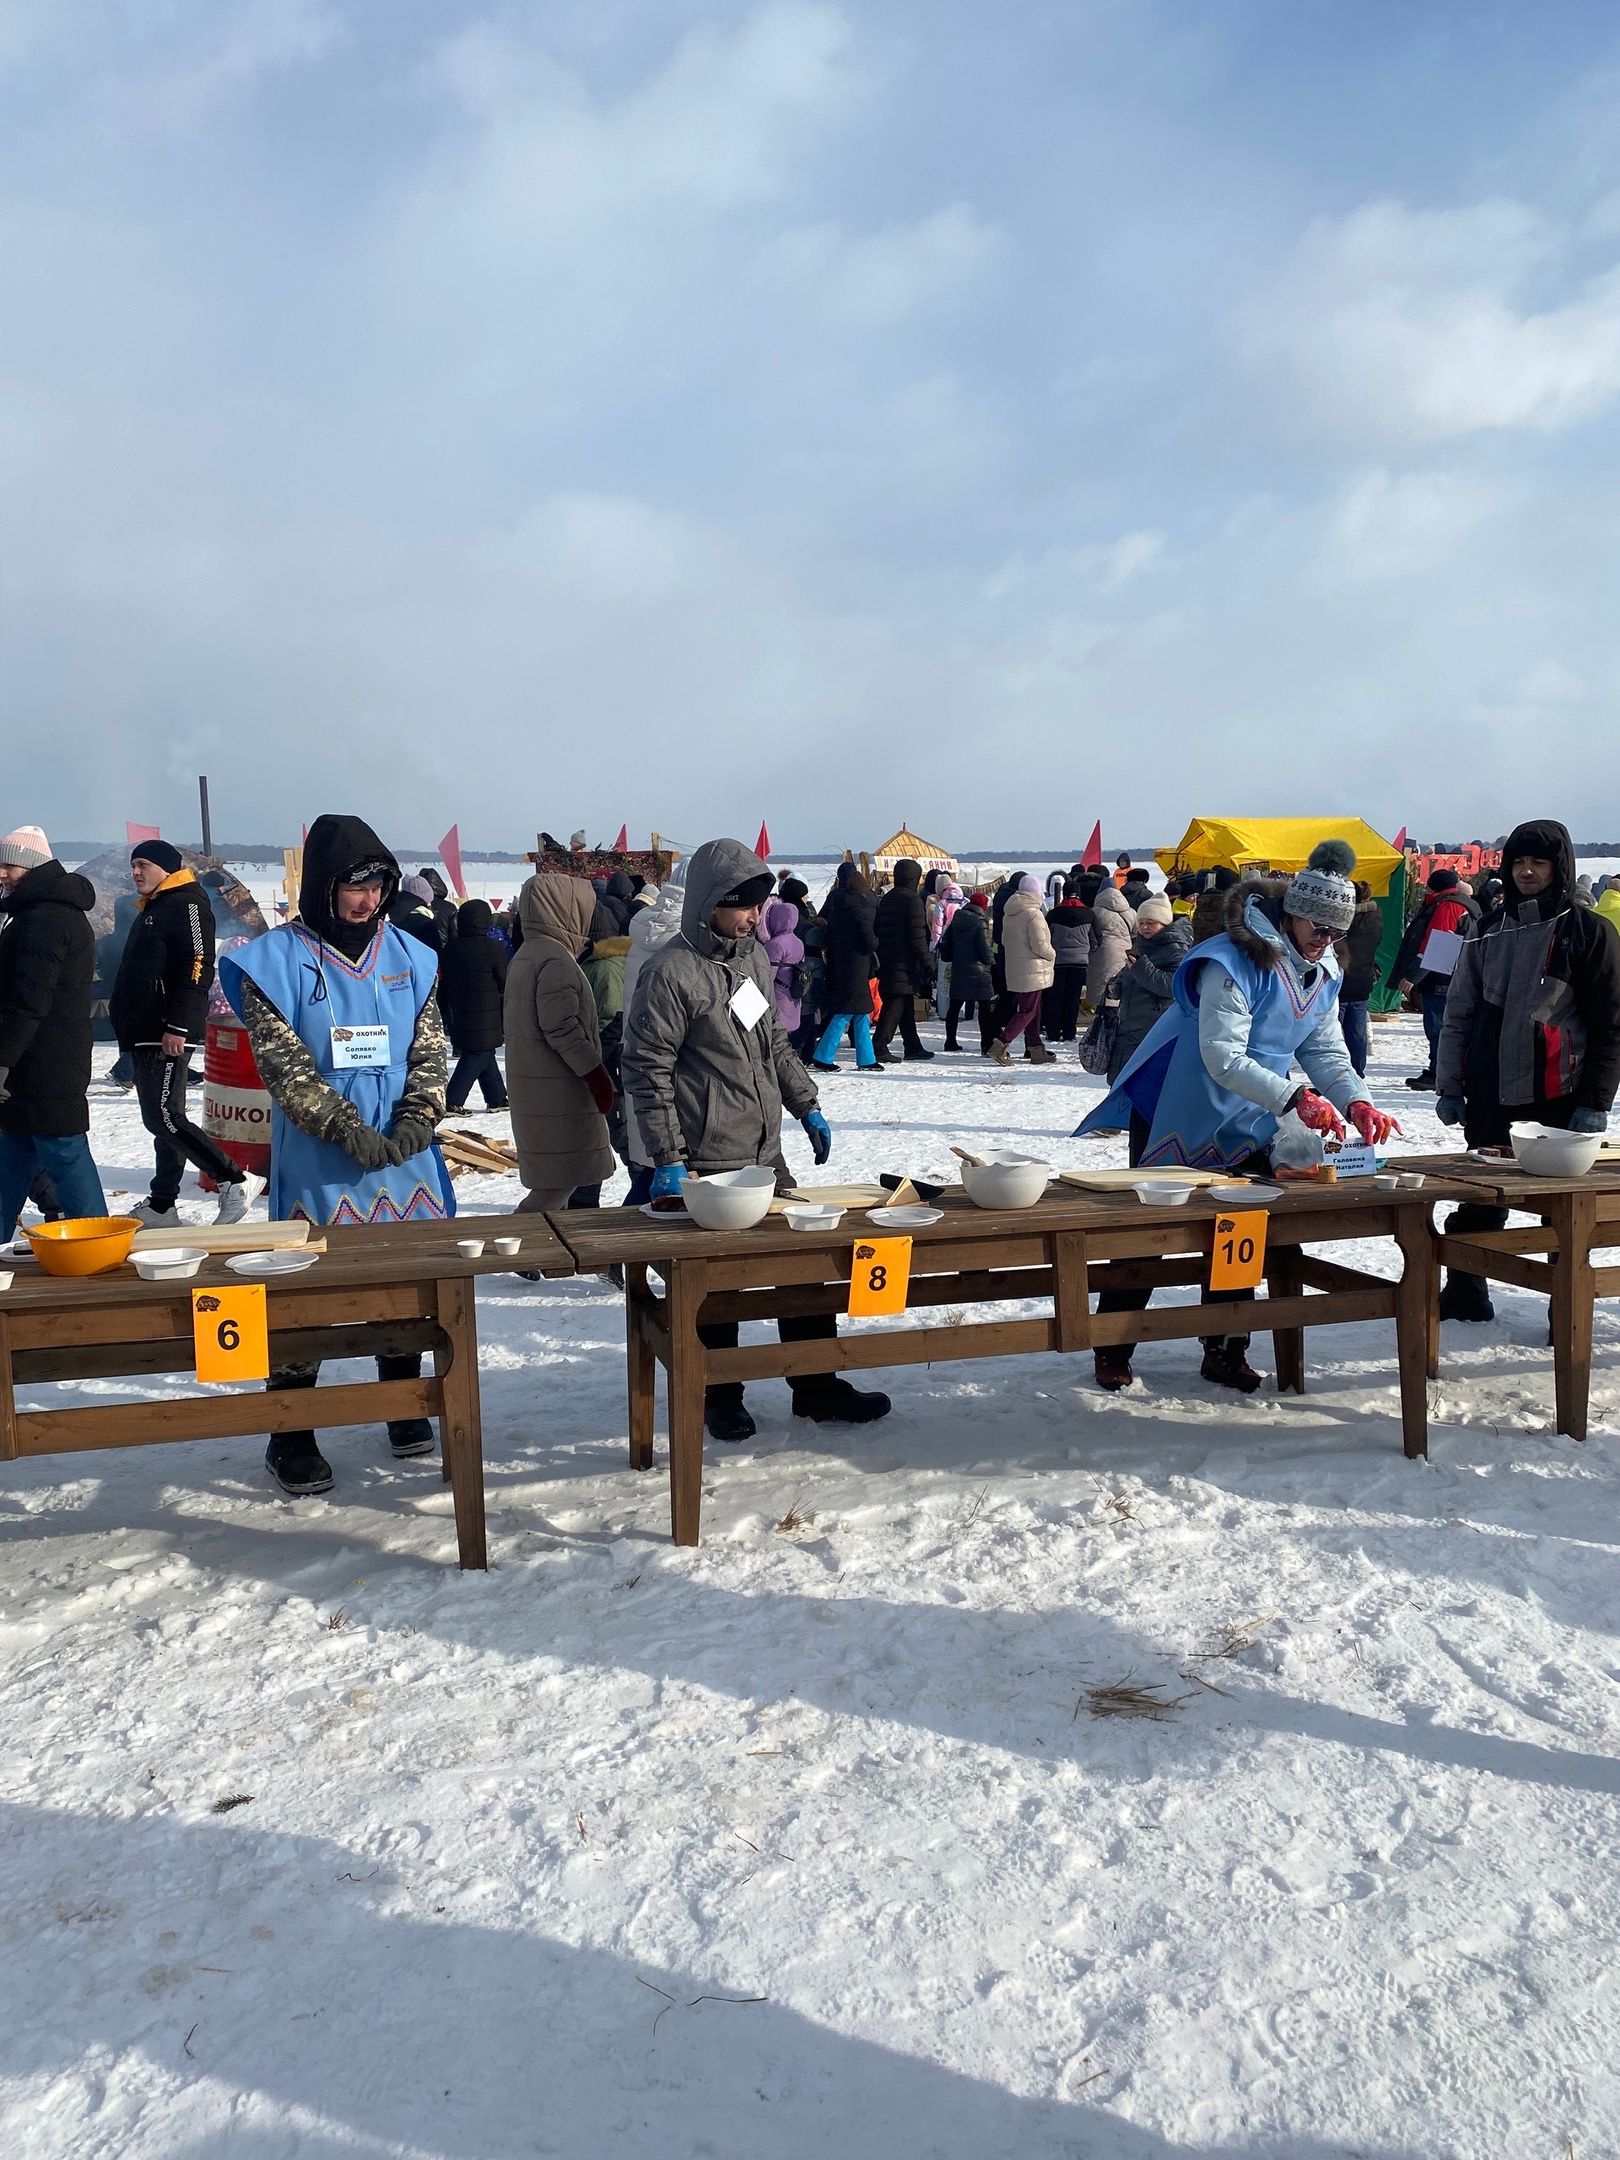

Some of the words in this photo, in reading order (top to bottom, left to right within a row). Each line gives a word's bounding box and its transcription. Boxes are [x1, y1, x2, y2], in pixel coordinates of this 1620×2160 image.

[214, 1102, 271, 1124] LUKOI
[1222, 1238, 1255, 1265] 10
[868, 1265, 887, 1292] 8
[217, 1319, 241, 1351] 6
